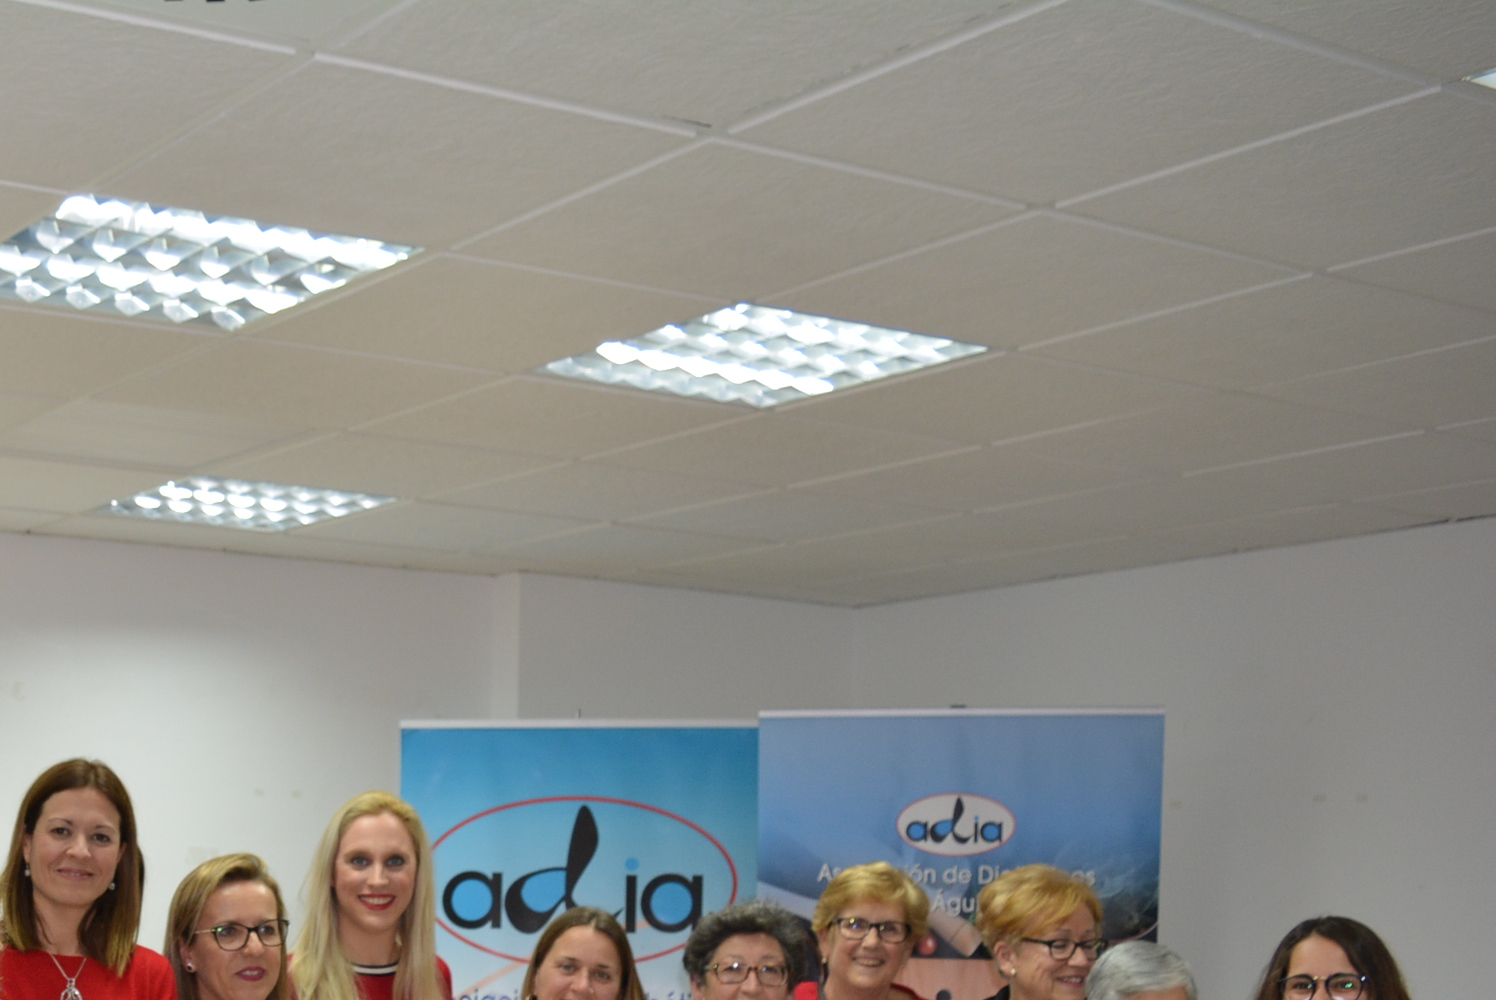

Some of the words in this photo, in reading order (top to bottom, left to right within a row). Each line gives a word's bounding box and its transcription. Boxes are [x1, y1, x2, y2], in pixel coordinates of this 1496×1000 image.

[906, 796, 1002, 843] adia
[442, 804, 703, 933] adia
[942, 865, 973, 884] de
[932, 890, 976, 917] Águ
